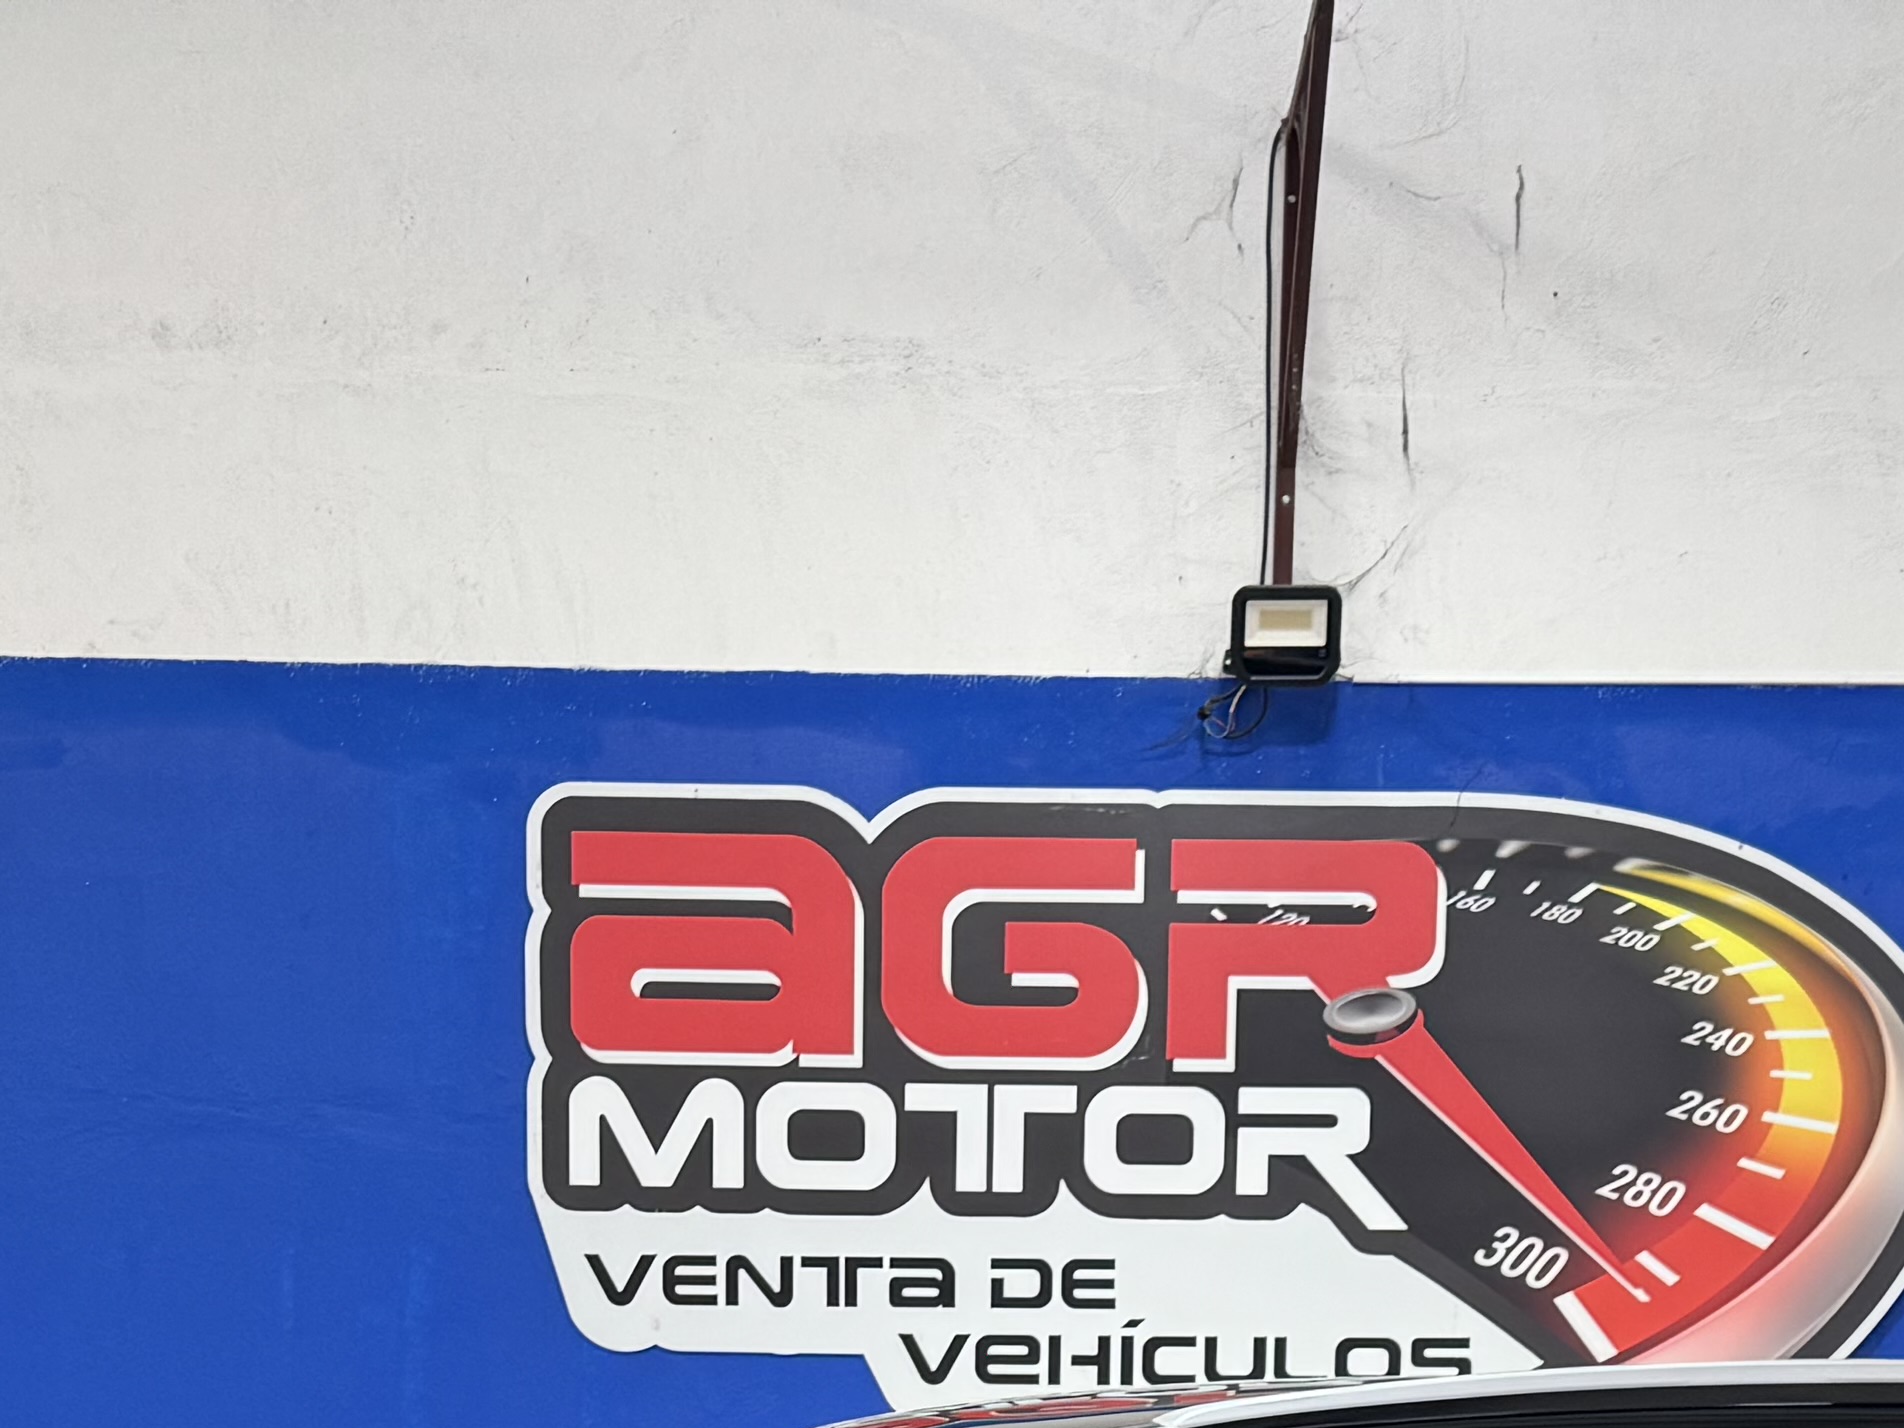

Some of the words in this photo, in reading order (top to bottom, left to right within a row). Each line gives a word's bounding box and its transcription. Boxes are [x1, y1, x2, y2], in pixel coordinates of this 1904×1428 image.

[1529, 901, 1584, 925] 180
[1599, 923, 1662, 955] 200
[1653, 964, 1719, 997] 220
[1681, 1020, 1755, 1060] 240
[1666, 1091, 1749, 1137] 260
[569, 1074, 1408, 1231] MOTOR
[1595, 1162, 1689, 1219] 280
[1475, 1225, 1572, 1292] 300
[989, 1256, 1117, 1311] DE
